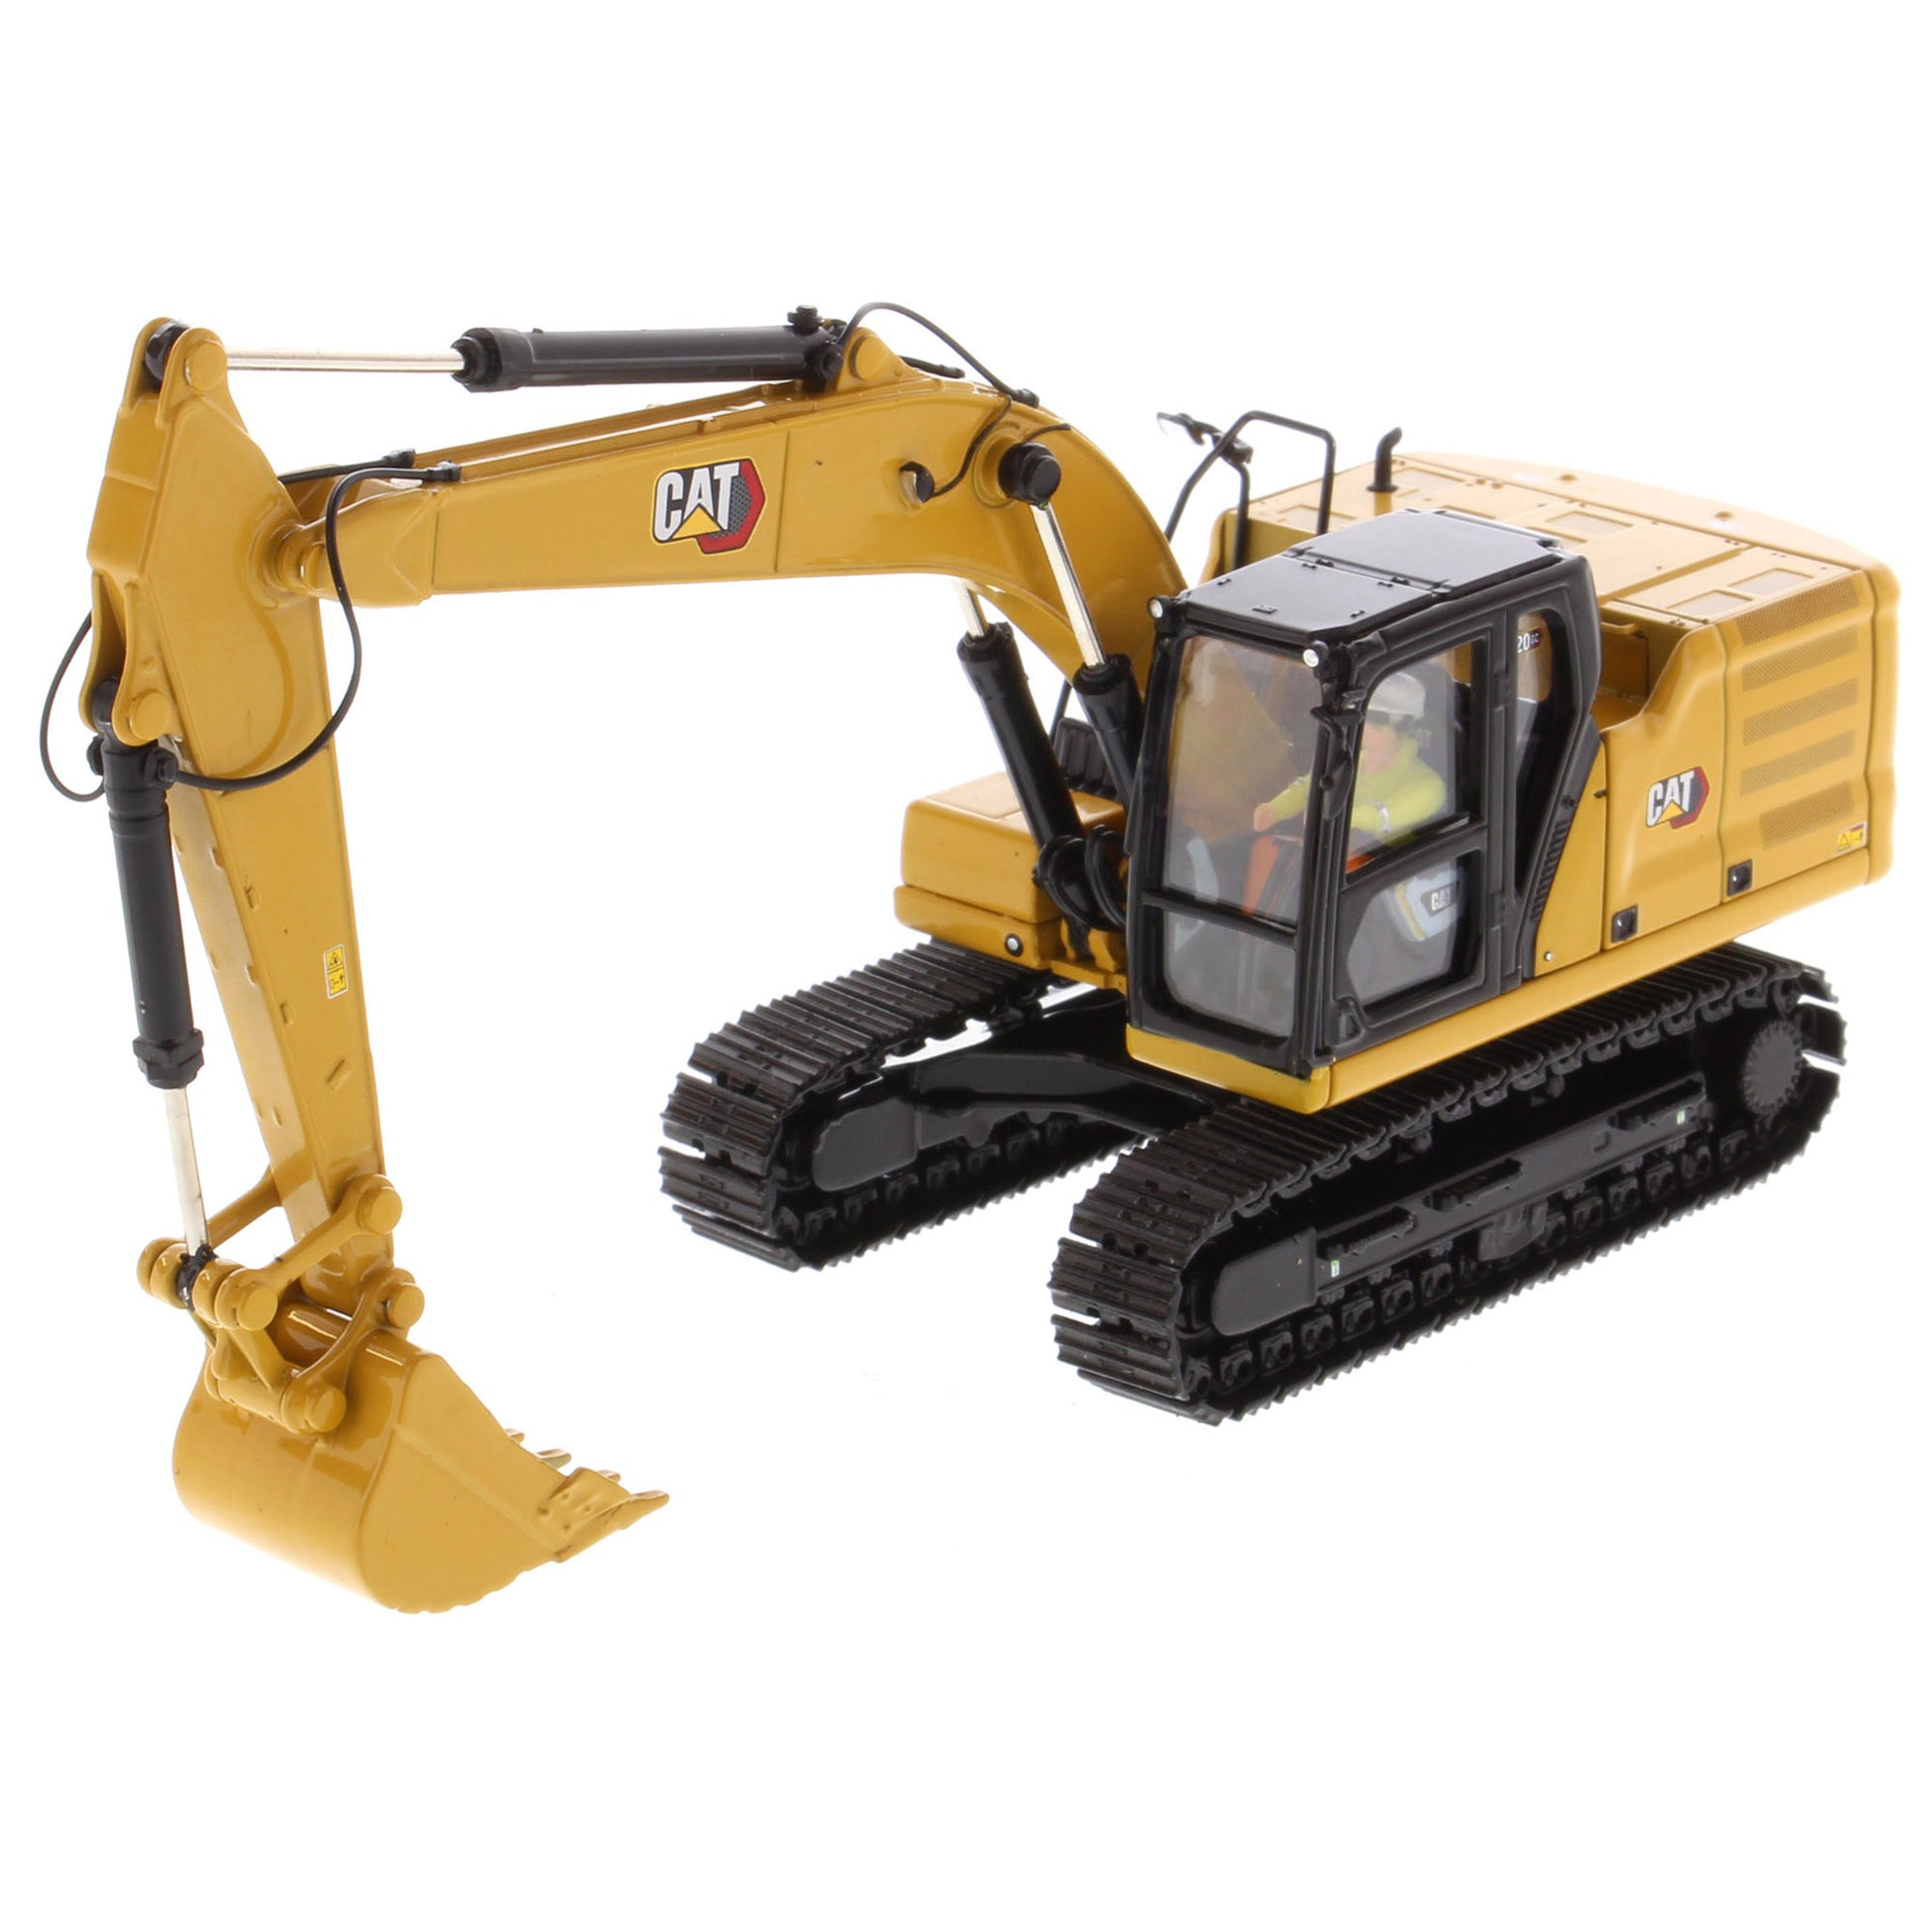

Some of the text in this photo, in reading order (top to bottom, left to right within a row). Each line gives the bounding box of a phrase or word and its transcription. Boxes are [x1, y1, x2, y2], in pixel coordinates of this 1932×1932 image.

[654, 462, 740, 541] CAT
[1518, 632, 1530, 653] 20
[1647, 769, 1695, 827] CAT
